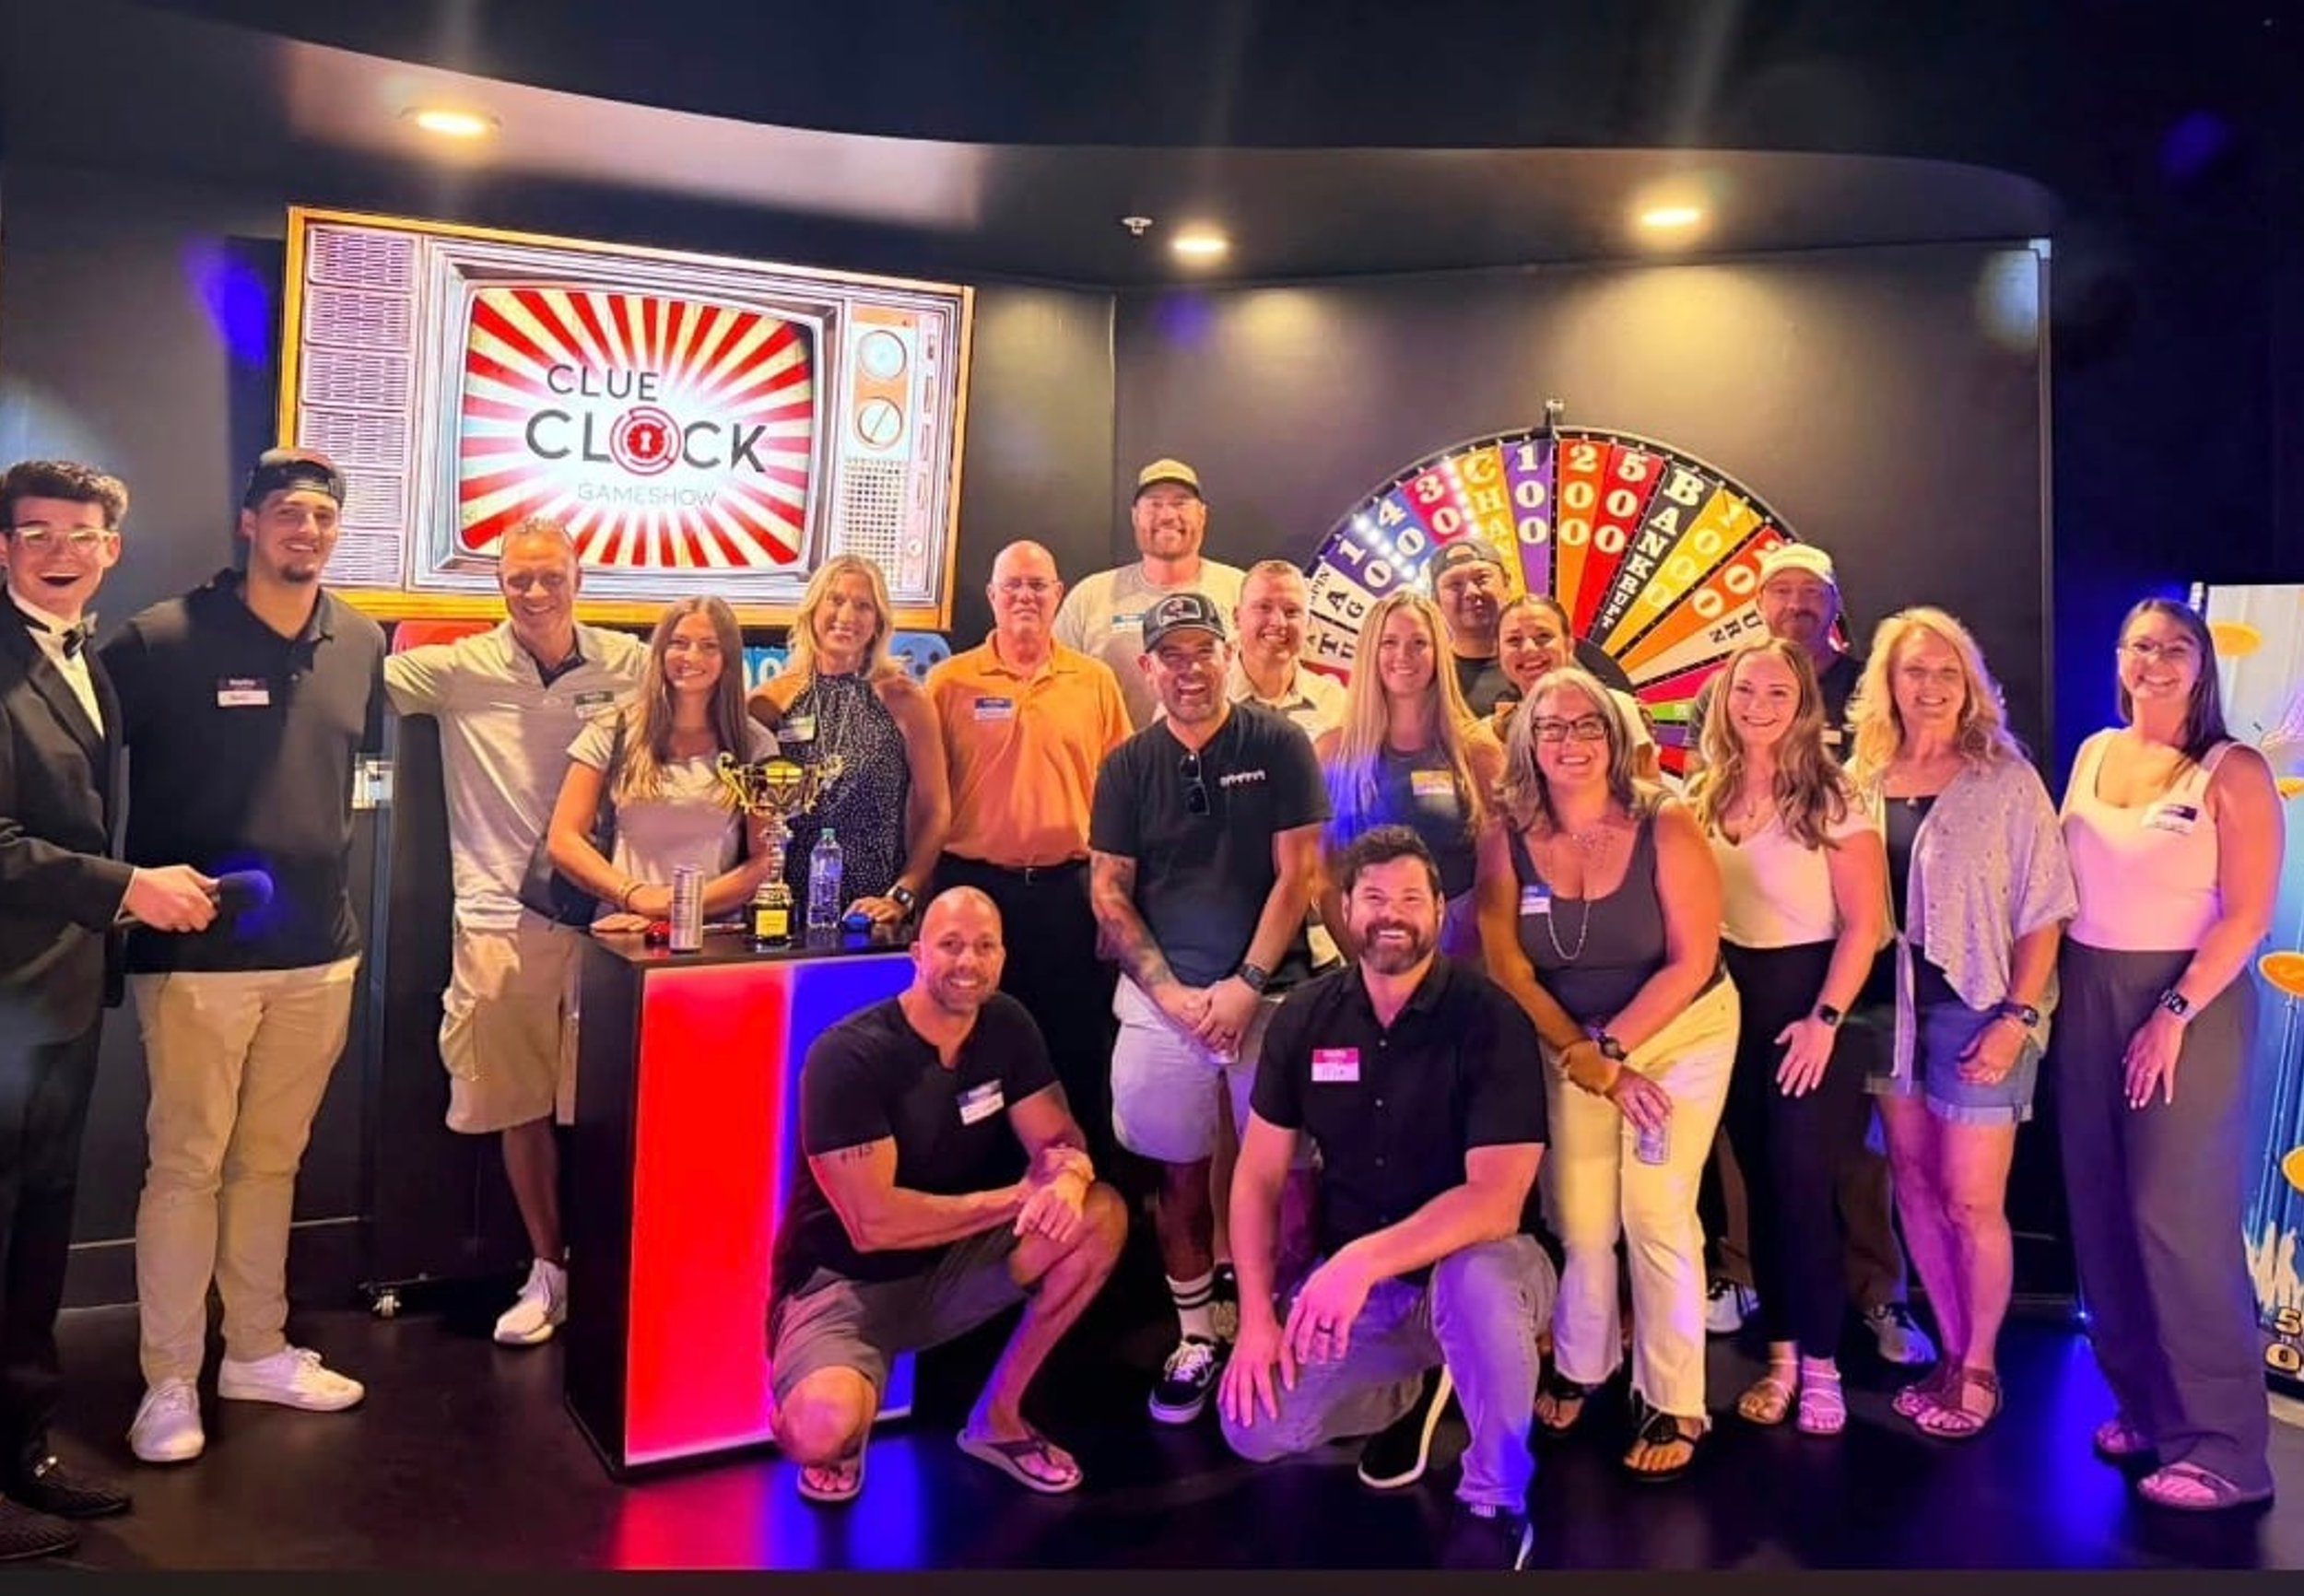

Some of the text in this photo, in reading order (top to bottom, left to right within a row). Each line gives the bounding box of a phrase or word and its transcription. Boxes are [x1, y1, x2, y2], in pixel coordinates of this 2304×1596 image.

[547, 363, 660, 402] CLUE
[578, 482, 717, 507] GAMESHOW
[1415, 474, 1462, 534] 30
[1515, 444, 1548, 544] 100
[1559, 444, 1597, 546] 200
[1593, 452, 1648, 553] 500
[1338, 538, 1392, 588] 10
[1602, 468, 1705, 628] BANKRUPT
[1710, 609, 1763, 643] URN
